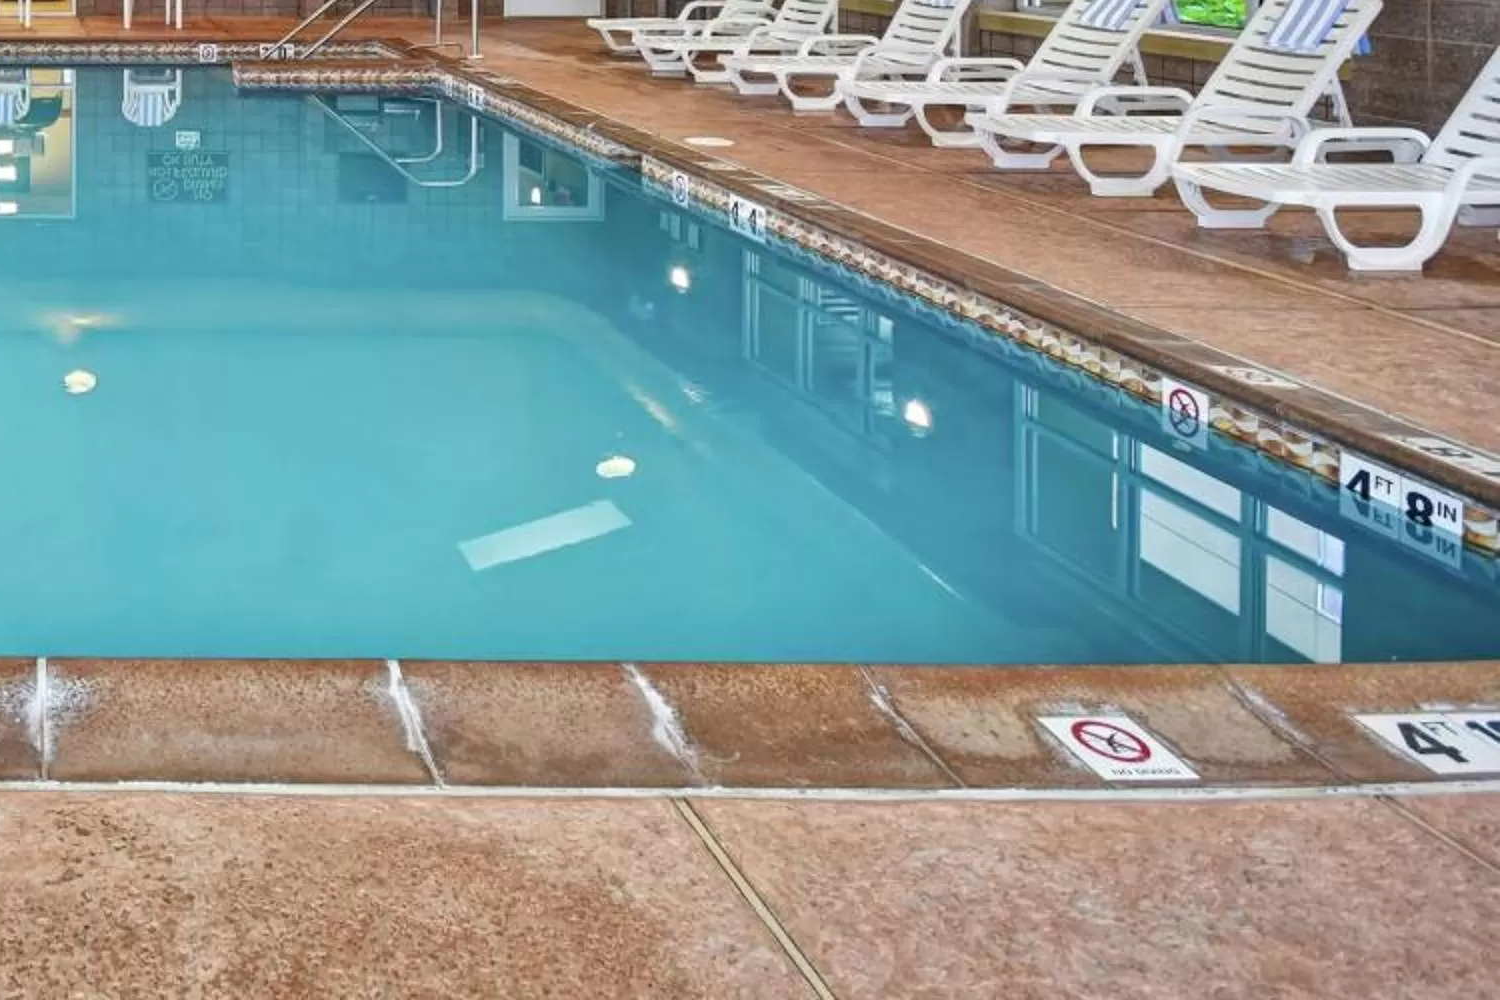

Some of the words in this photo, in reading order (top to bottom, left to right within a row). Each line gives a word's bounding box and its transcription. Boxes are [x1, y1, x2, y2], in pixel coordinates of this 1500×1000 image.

[1346, 470, 1370, 501] 4
[1375, 475, 1394, 495] FT
[1405, 491, 1434, 527] 8
[1436, 501, 1457, 523] IN
[1396, 721, 1470, 763] 4
